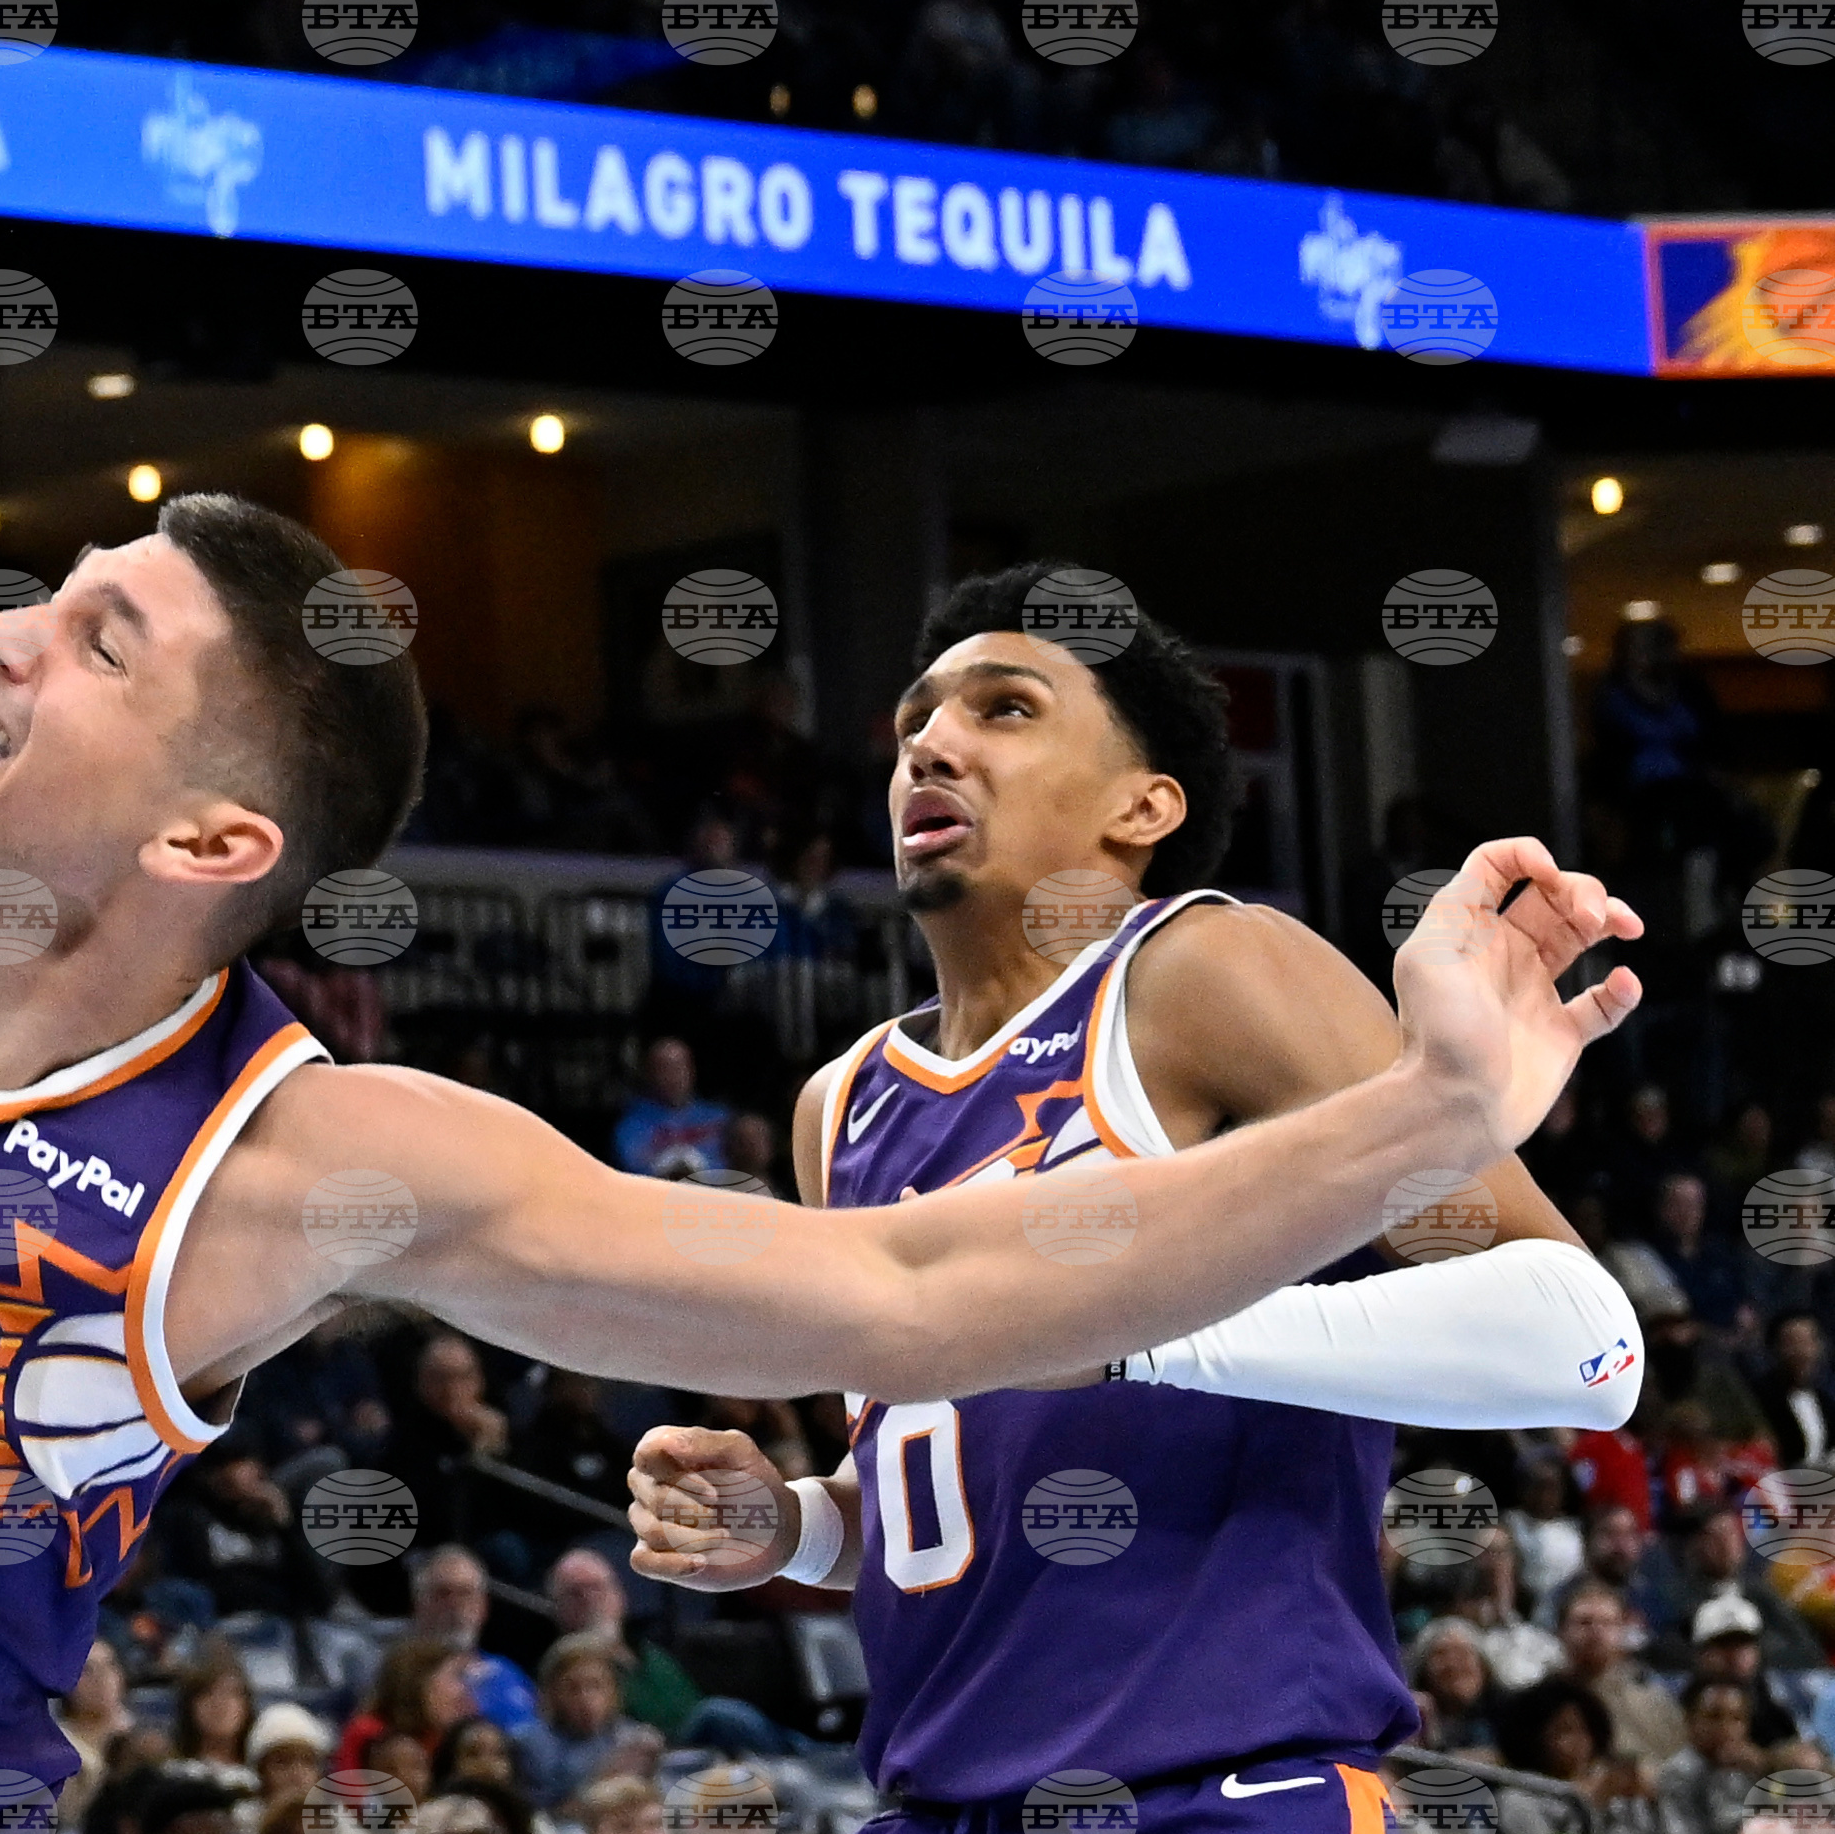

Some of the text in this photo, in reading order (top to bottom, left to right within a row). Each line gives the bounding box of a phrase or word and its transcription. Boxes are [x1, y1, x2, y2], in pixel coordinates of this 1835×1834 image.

[423, 127, 813, 251] MILAGRO
[837, 169, 1191, 290] TEQUILA
[3, 1118, 146, 1219] PayPal
[875, 1398, 974, 1595] 0
